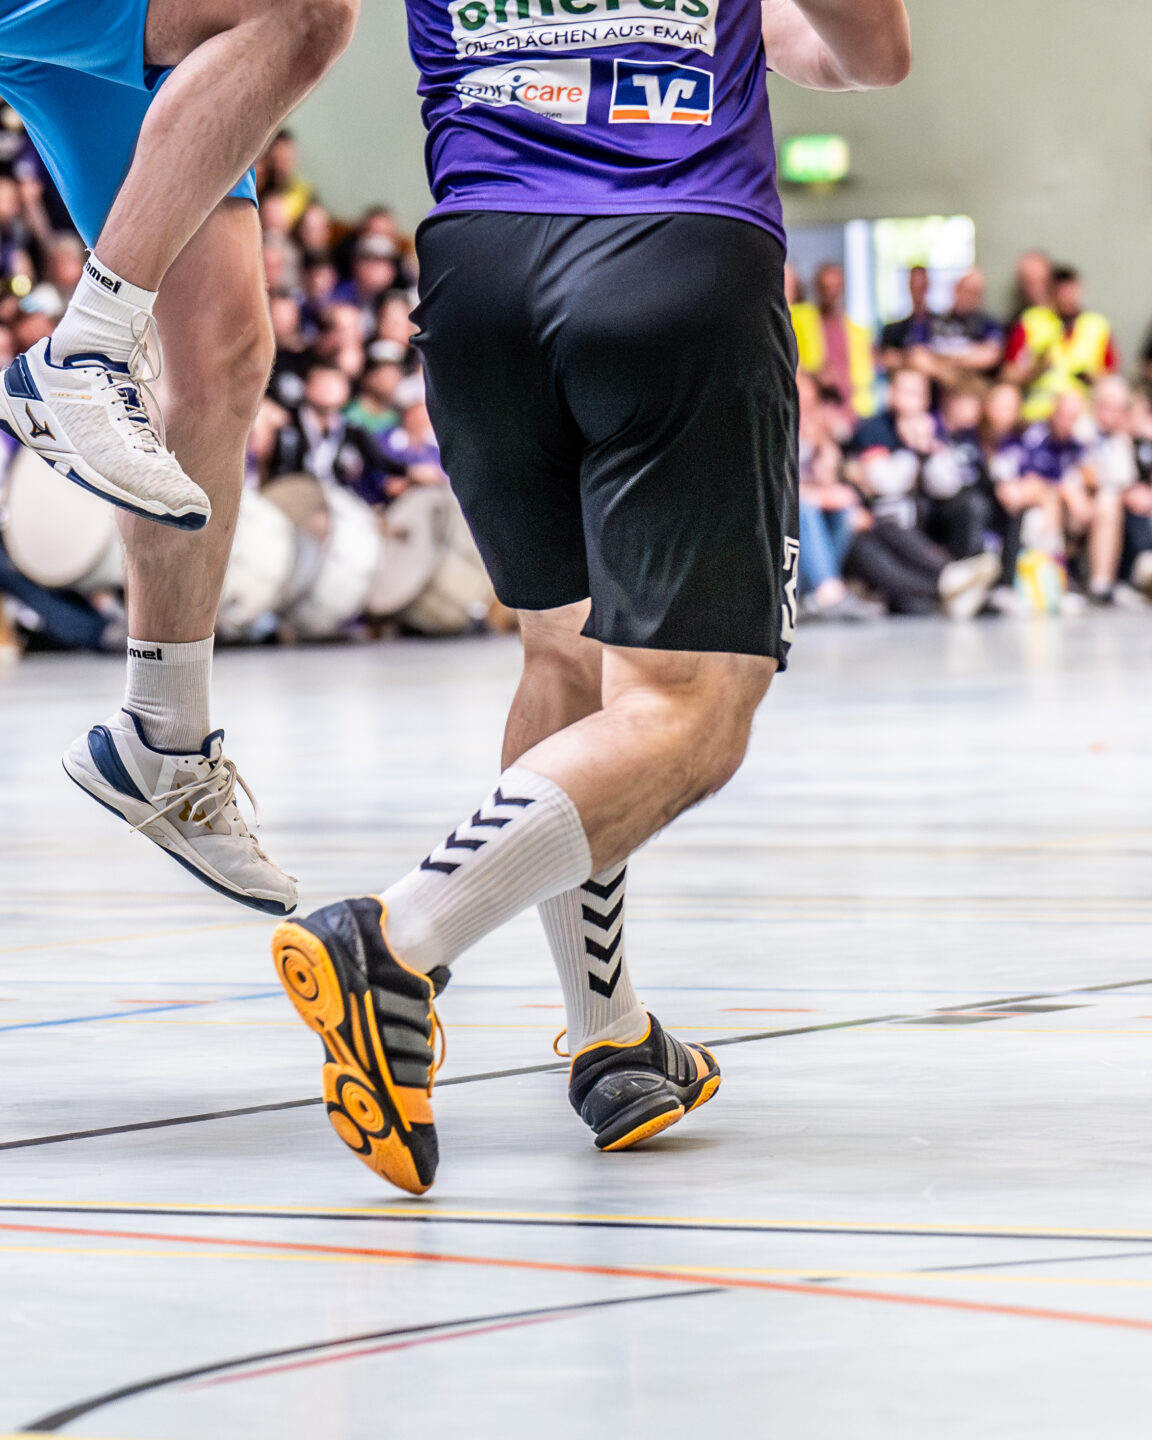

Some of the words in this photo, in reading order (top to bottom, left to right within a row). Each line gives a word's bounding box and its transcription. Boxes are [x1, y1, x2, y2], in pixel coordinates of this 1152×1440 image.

[604, 25, 645, 39] AUS
[653, 25, 708, 46] EMAIL
[523, 83, 583, 103] care
[127, 647, 163, 661] mel
